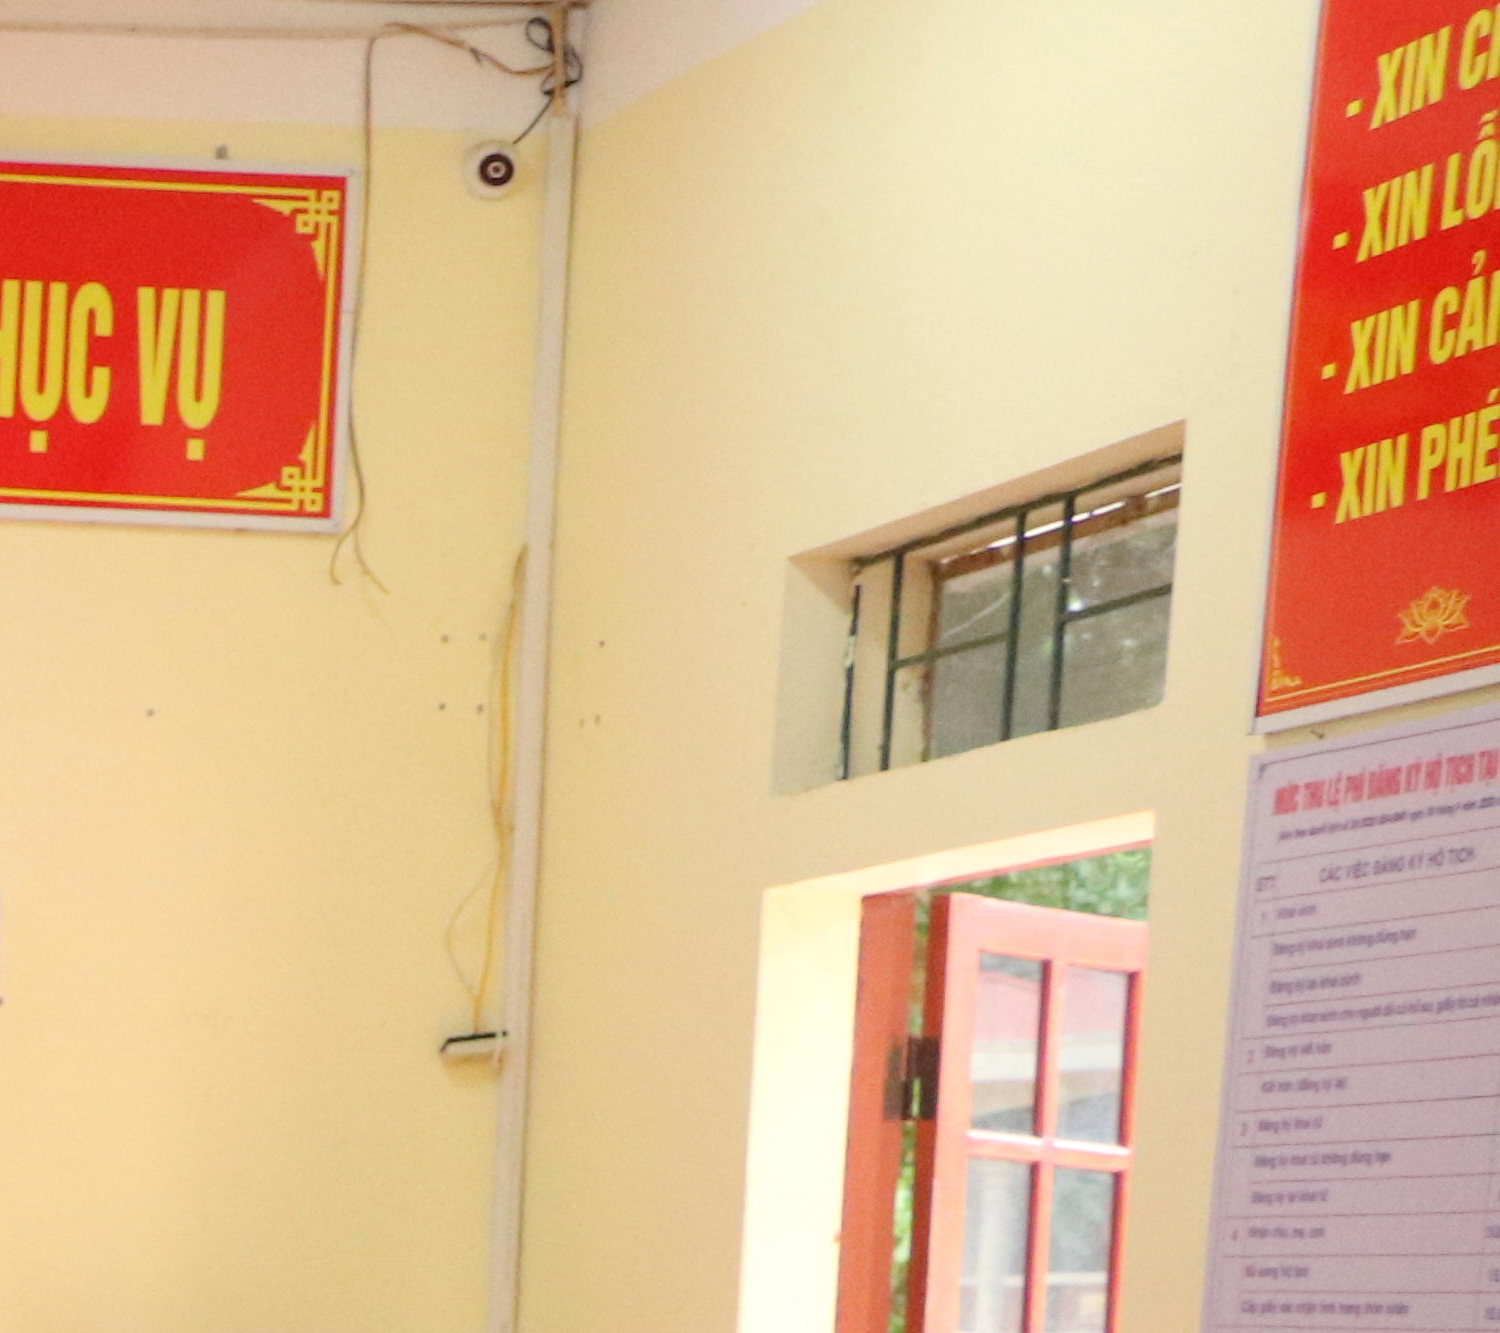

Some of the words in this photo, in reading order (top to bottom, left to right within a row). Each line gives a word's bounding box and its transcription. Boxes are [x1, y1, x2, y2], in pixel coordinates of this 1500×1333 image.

[1369, 25, 1453, 130] XIN
[1356, 163, 1435, 263] XIN
[138, 288, 226, 460] VỤ
[1343, 299, 1421, 395] XIN
[1334, 433, 1409, 524] XIN
[1416, 388, 1500, 500] PHÉ
